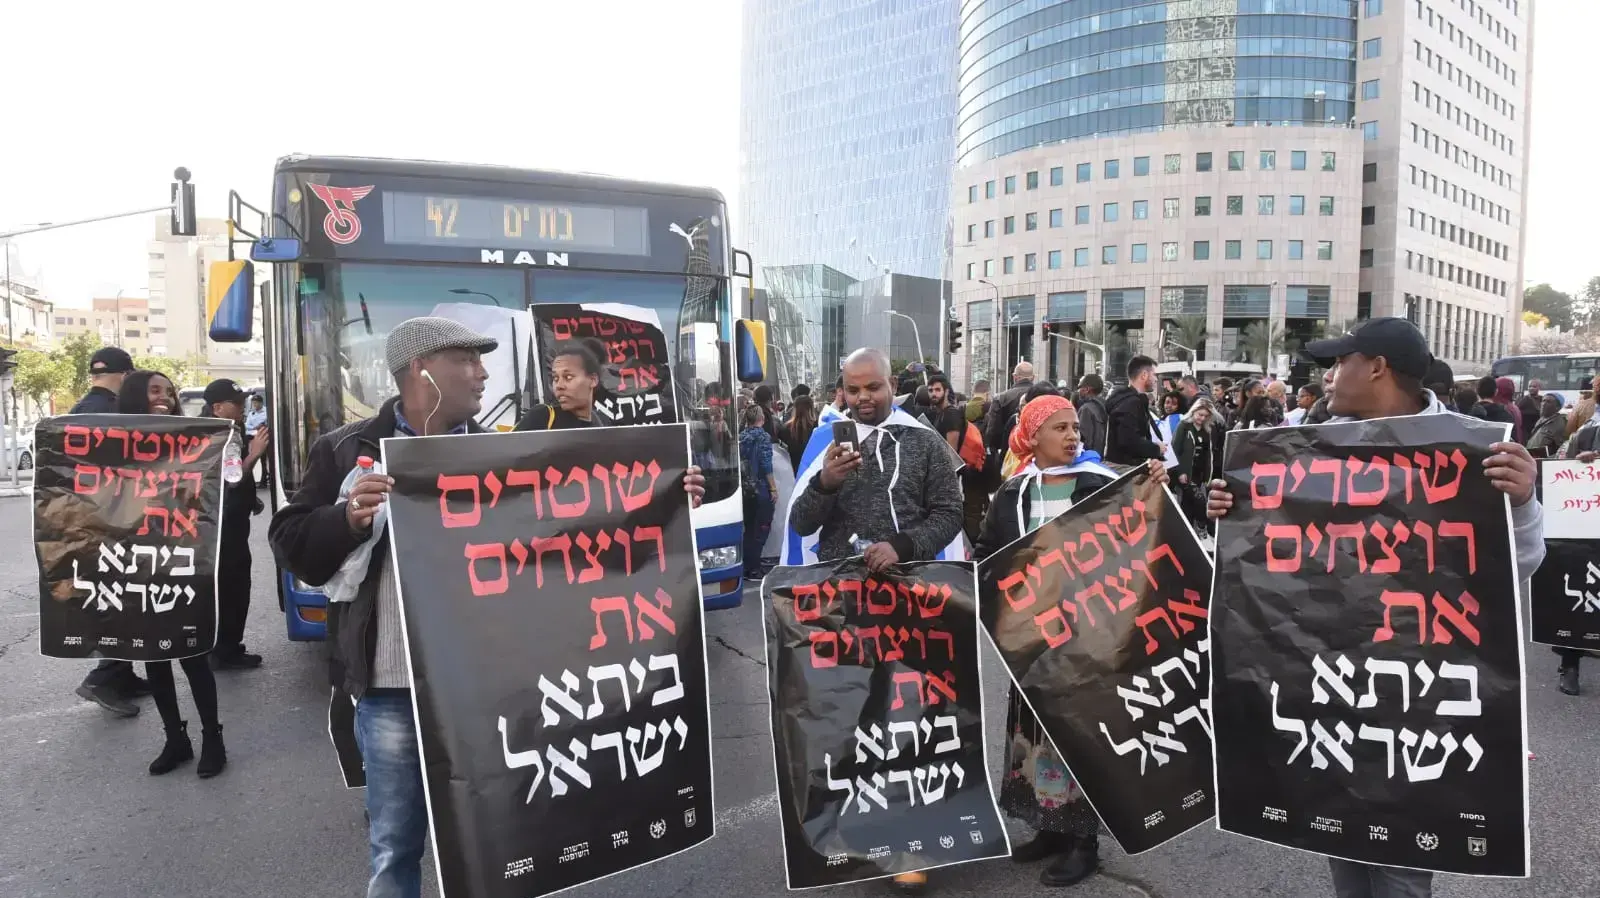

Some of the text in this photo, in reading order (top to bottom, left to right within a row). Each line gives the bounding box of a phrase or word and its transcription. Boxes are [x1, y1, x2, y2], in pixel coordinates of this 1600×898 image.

[428, 198, 459, 237] 42
[480, 249, 569, 266] MAN
[617, 364, 660, 391] את
[64, 424, 212, 464] שוטרים
[74, 464, 202, 499] רוצחים
[436, 459, 662, 528] שוטרים
[1251, 448, 1468, 509] שוטרים
[136, 505, 197, 538] את
[1265, 520, 1477, 575] רוצחים
[98, 542, 195, 576] ביתא
[464, 525, 666, 596] רוצחים
[997, 499, 1148, 613] שוטרים
[72, 559, 196, 613] ישראל
[792, 578, 953, 621] שוטרים
[1033, 543, 1185, 650] רוצחים
[589, 588, 676, 650] את
[1135, 587, 1209, 655] את
[1373, 590, 1481, 646] את
[809, 625, 954, 668] רוצחים
[537, 653, 684, 728] ביתא
[891, 670, 957, 711] את
[1312, 654, 1482, 717] ביתא
[854, 715, 961, 764] ביתא
[1099, 699, 1212, 776] ראל
[1270, 680, 1484, 783] ישראל
[498, 715, 690, 805] ישראל
[824, 752, 965, 816] ישראל
[1310, 822, 1342, 834] השופטת
[1369, 825, 1388, 834] גלעד
[1369, 832, 1388, 841] ארדן
[1459, 812, 1485, 821] בחסות
